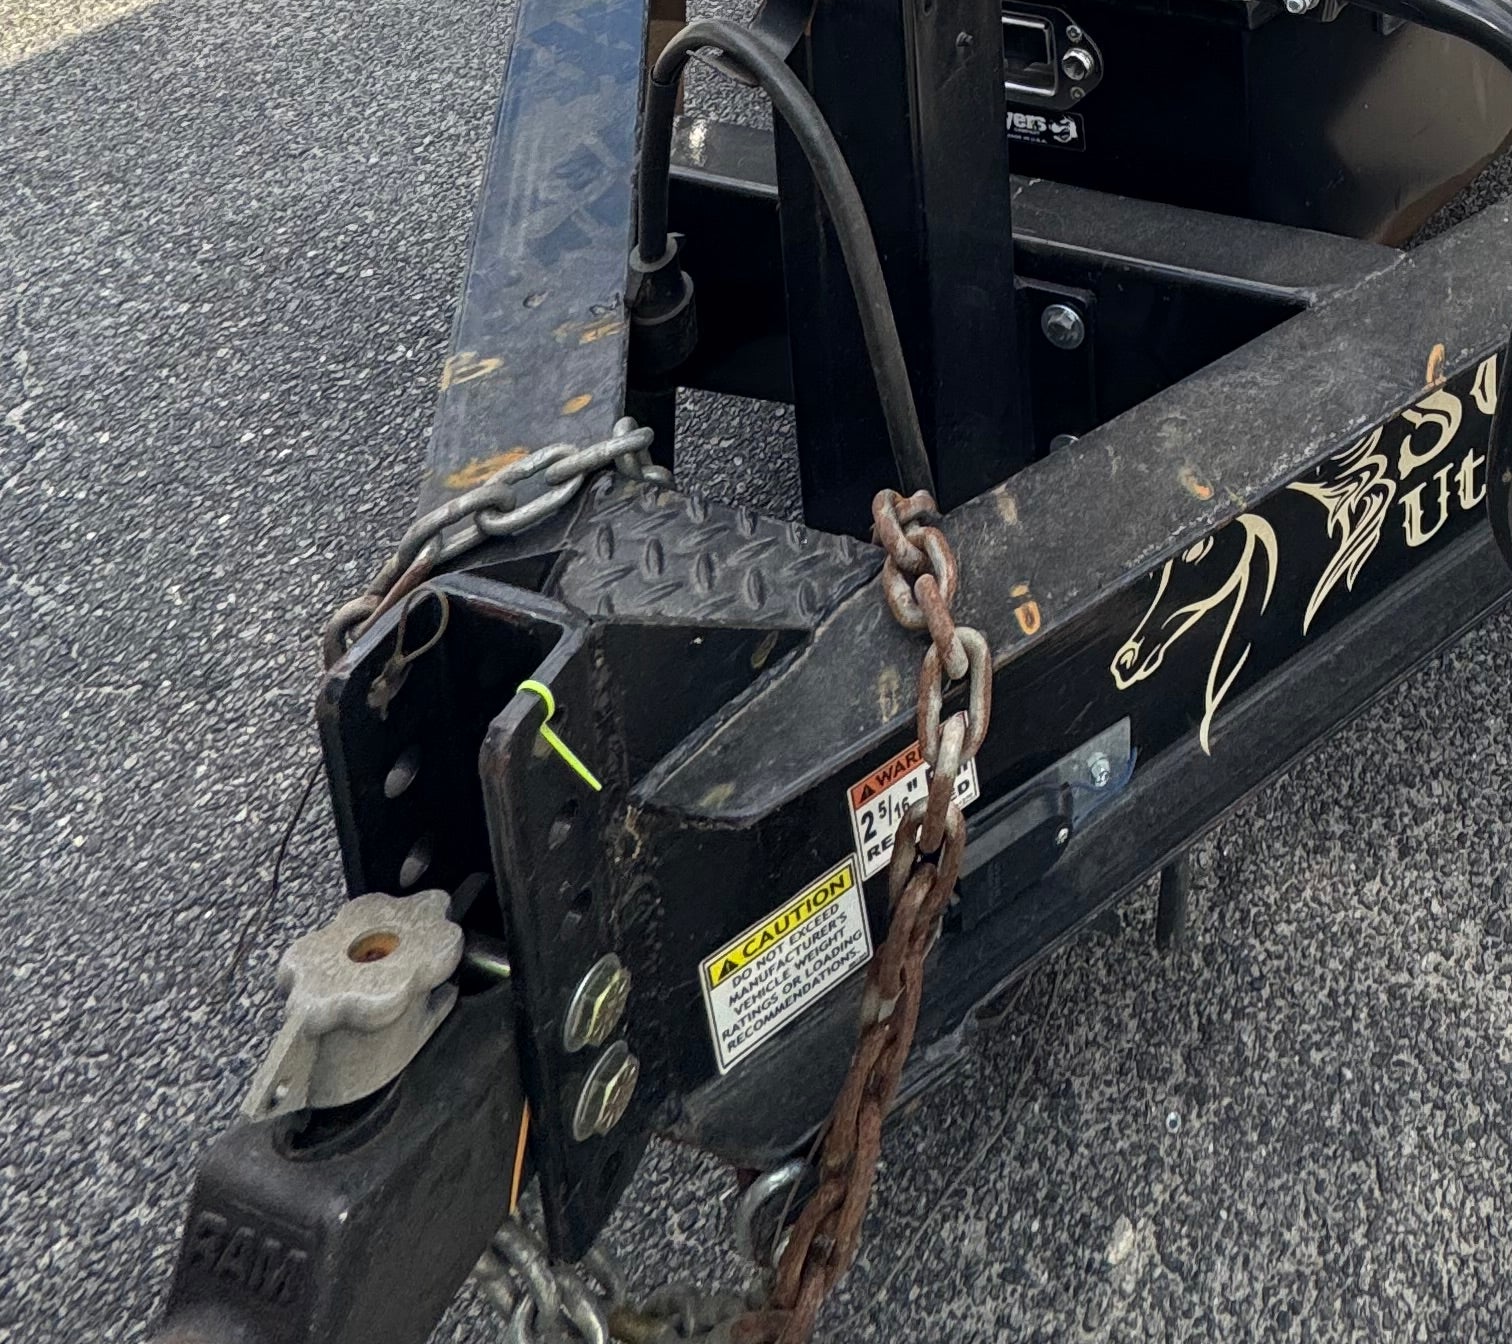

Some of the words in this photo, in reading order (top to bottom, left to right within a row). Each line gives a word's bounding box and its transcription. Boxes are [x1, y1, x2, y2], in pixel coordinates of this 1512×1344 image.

[1006, 111, 1047, 131] yers
[861, 810, 877, 844] 2
[728, 912, 848, 1006] MANUFACTURER'S
[732, 967, 753, 989] DO
[756, 944, 785, 971] NOT
[789, 903, 839, 947] EXCEED
[742, 874, 845, 959] CAUTION
[722, 994, 779, 1042] RATINGS
[782, 976, 802, 995] OR
[805, 929, 862, 980] LOADING
[733, 969, 791, 1016] VEHICLE
[794, 926, 847, 971] WEIGHT
